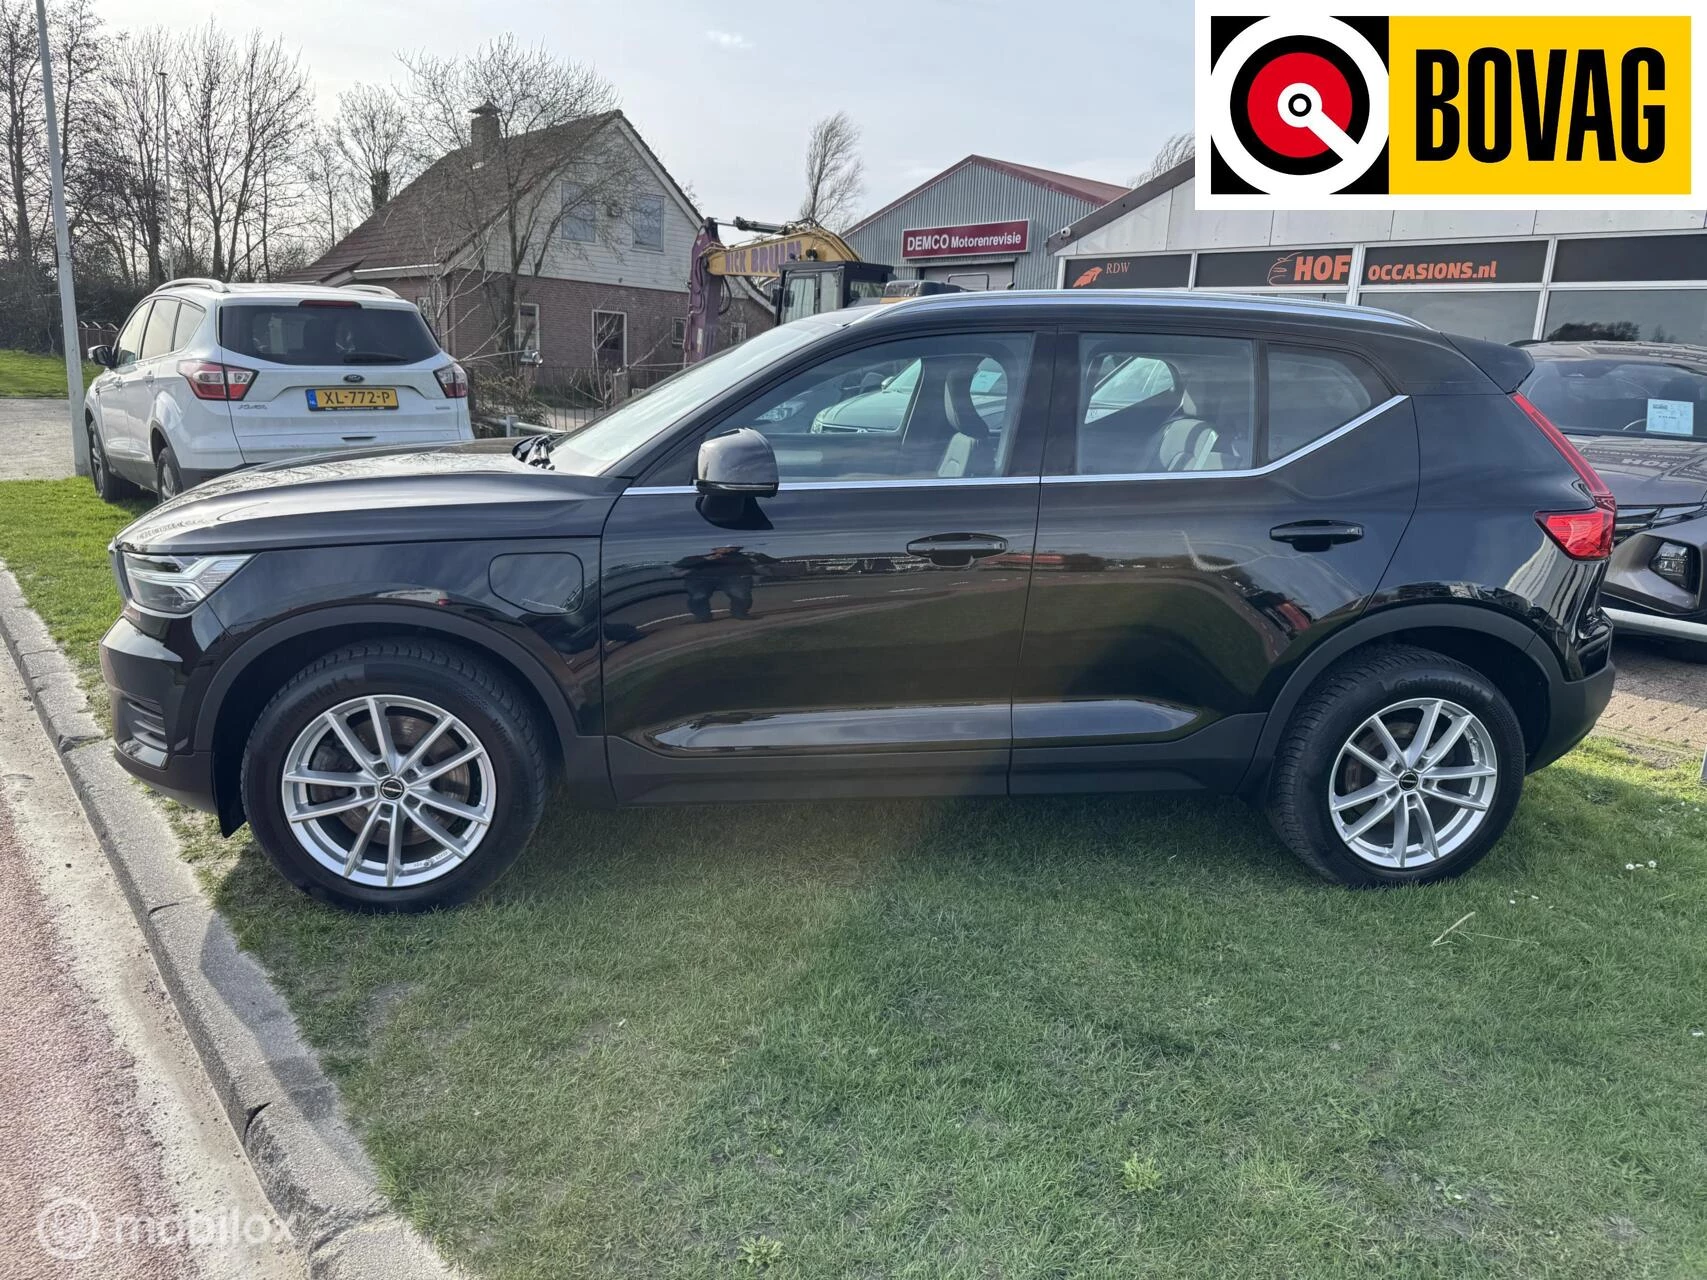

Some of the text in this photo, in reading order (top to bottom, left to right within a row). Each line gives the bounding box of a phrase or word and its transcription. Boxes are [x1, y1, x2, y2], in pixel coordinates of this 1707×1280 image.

[907, 232, 1022, 251] DEMCO Motorenrevisie
[1106, 262, 1130, 274] RDW
[1294, 255, 1497, 281] HOF OCCASIONS.nl
[324, 391, 390, 404] XL-772-P
